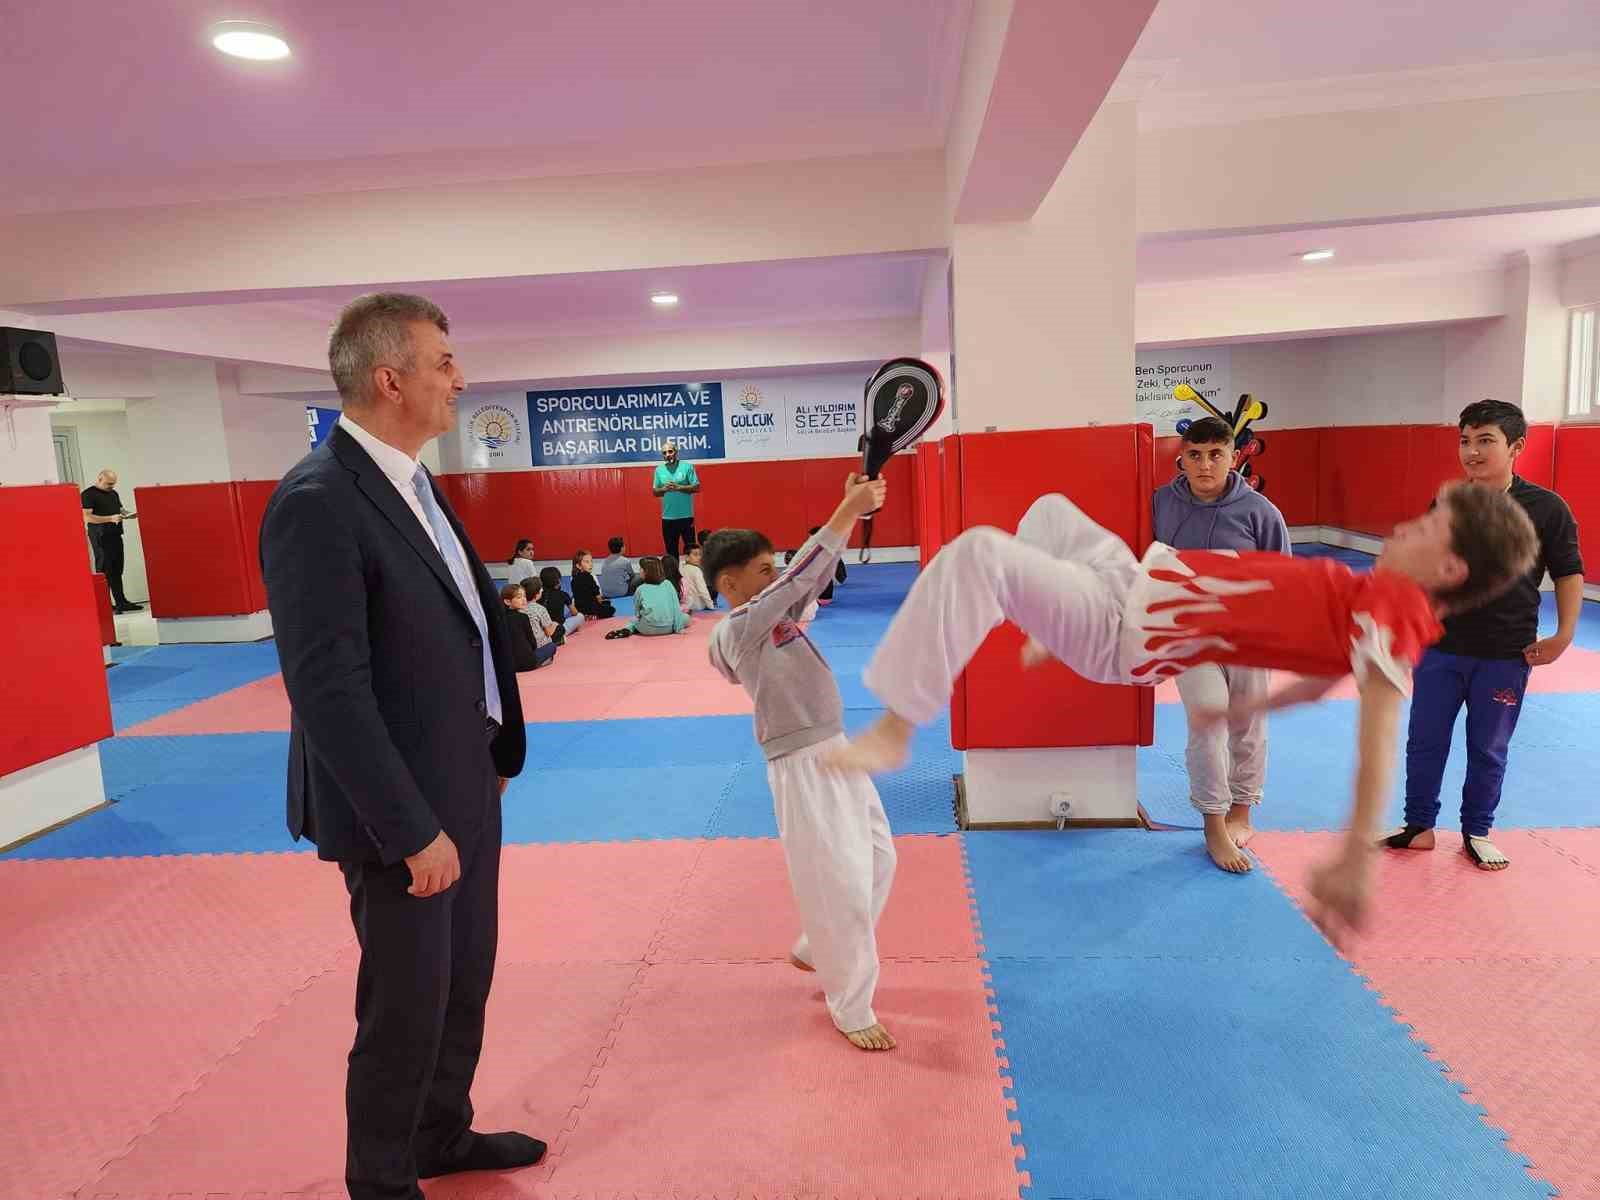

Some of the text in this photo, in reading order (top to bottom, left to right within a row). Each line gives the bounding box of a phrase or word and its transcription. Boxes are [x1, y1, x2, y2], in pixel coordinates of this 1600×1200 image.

[1157, 363, 1212, 376] Sporcunun
[1193, 377, 1206, 385] ve
[536, 390, 712, 413] SPORCULARIMIZA VE
[541, 412, 710, 435] ANTRENÖRLERİMİZE
[795, 412, 857, 429] SEZER
[542, 438, 637, 459] BAŞARILAR
